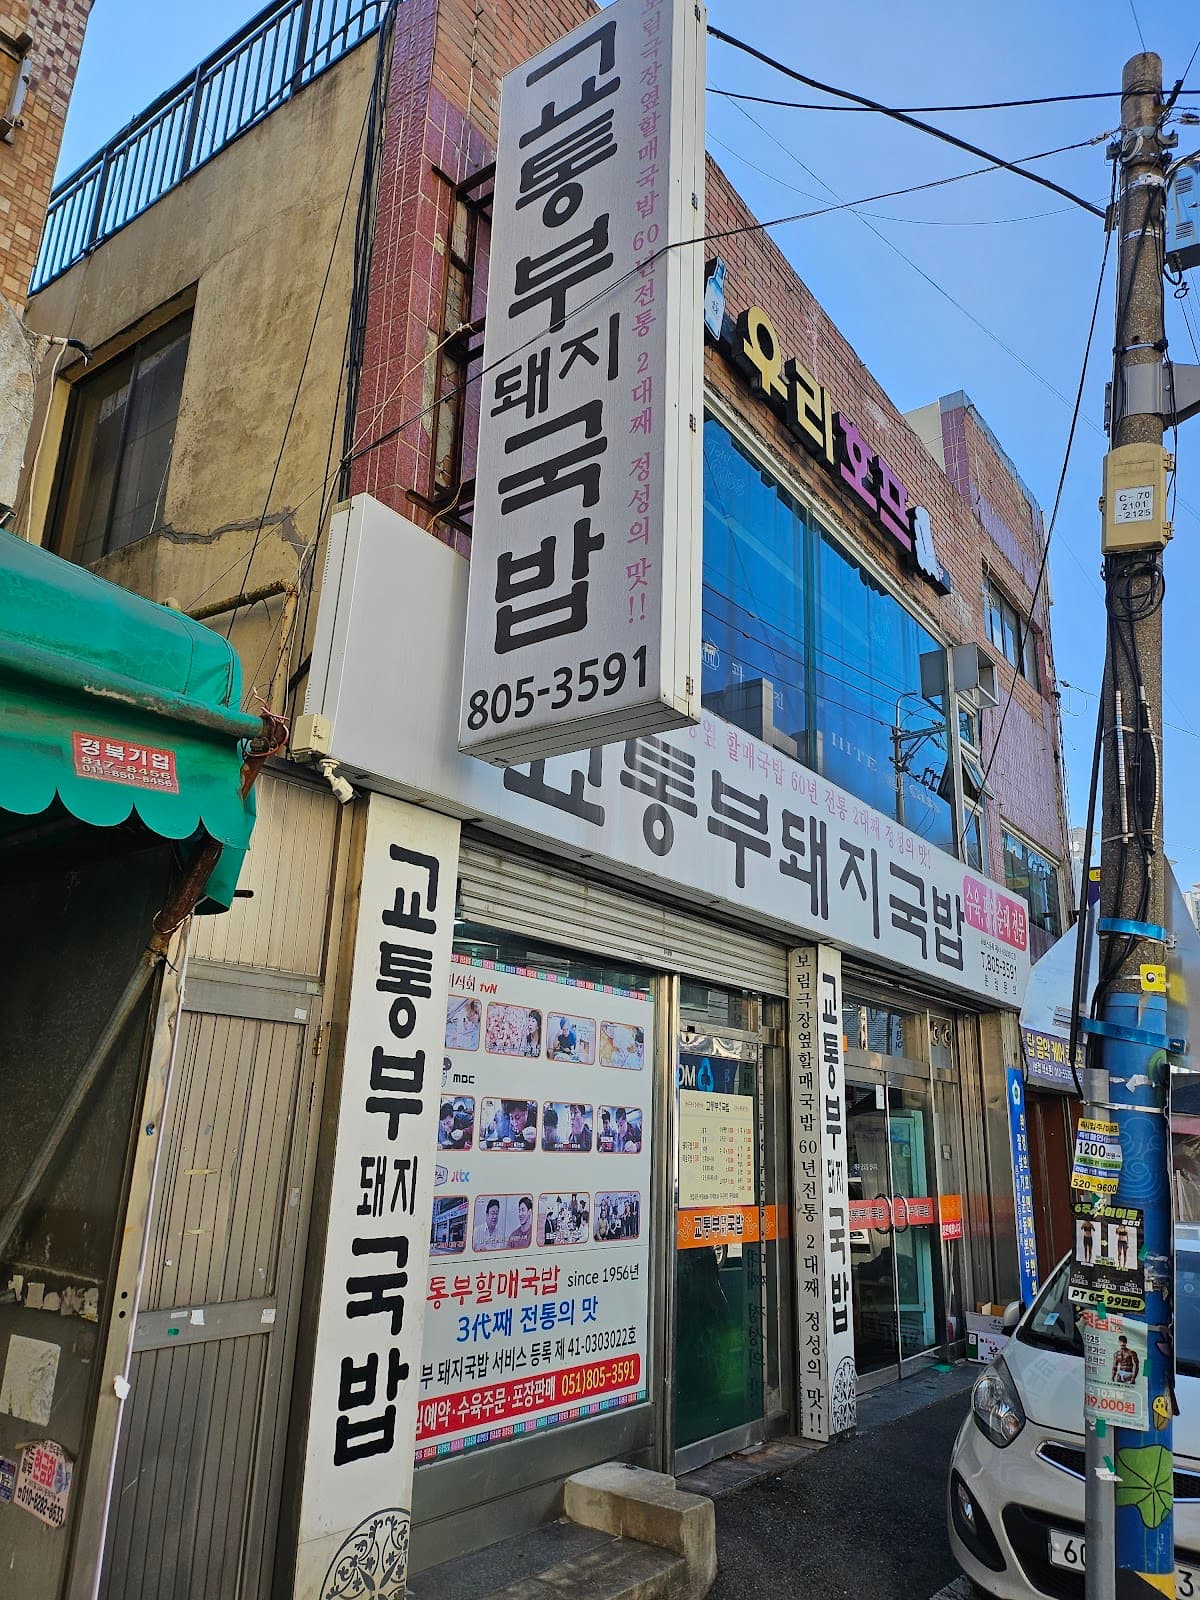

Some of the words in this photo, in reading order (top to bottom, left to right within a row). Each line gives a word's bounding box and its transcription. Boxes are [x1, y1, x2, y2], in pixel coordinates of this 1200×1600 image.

[1122, 501, 1147, 511] 2101
[467, 644, 648, 731] 805-3591
[80, 738, 169, 770] 경북기업
[480, 983, 498, 994] tvN
[1072, 1179, 1117, 1193] 520-9600
[426, 1264, 560, 1310] 통부할매국밥
[567, 1270, 599, 1287] since
[602, 1263, 640, 1284] 1956년
[803, 1234, 820, 1298] 2대째
[1072, 1289, 1087, 1300] PT
[456, 1308, 513, 1343] 3代째
[519, 1299, 575, 1334] 전통의
[582, 1295, 599, 1324] 맛
[420, 1363, 434, 1390] 부
[437, 1351, 489, 1385] 돼지국밥
[492, 1347, 527, 1375] 서비스
[530, 1340, 551, 1368] 등록
[554, 1337, 565, 1361] 제
[567, 1325, 637, 1358] 41-0303022호
[805, 1312, 822, 1380] 정성의
[561, 1360, 636, 1397] 051)805-3591
[806, 1388, 824, 1434] 맛!!
